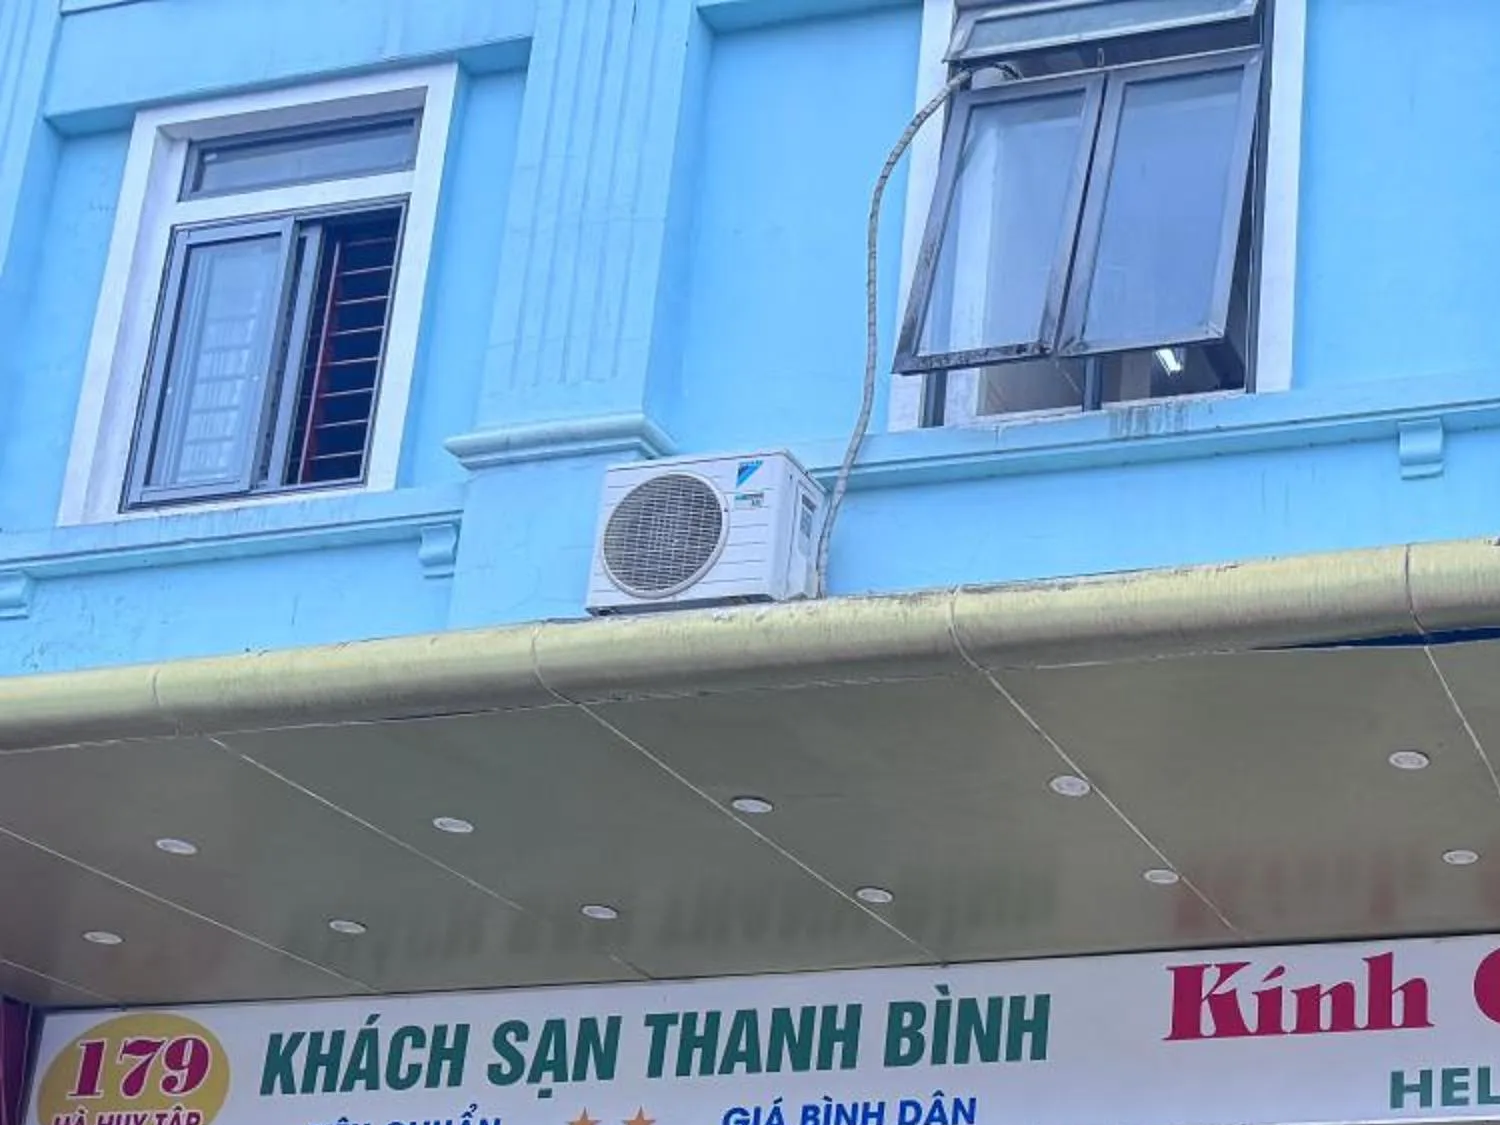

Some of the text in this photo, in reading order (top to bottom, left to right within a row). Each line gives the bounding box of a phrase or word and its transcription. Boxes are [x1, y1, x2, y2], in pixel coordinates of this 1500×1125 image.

[259, 984, 1052, 1099] KHÁCH SẠN THANH BÌNH
[1163, 951, 1434, 1042] Kính
[67, 1037, 213, 1099] 179
